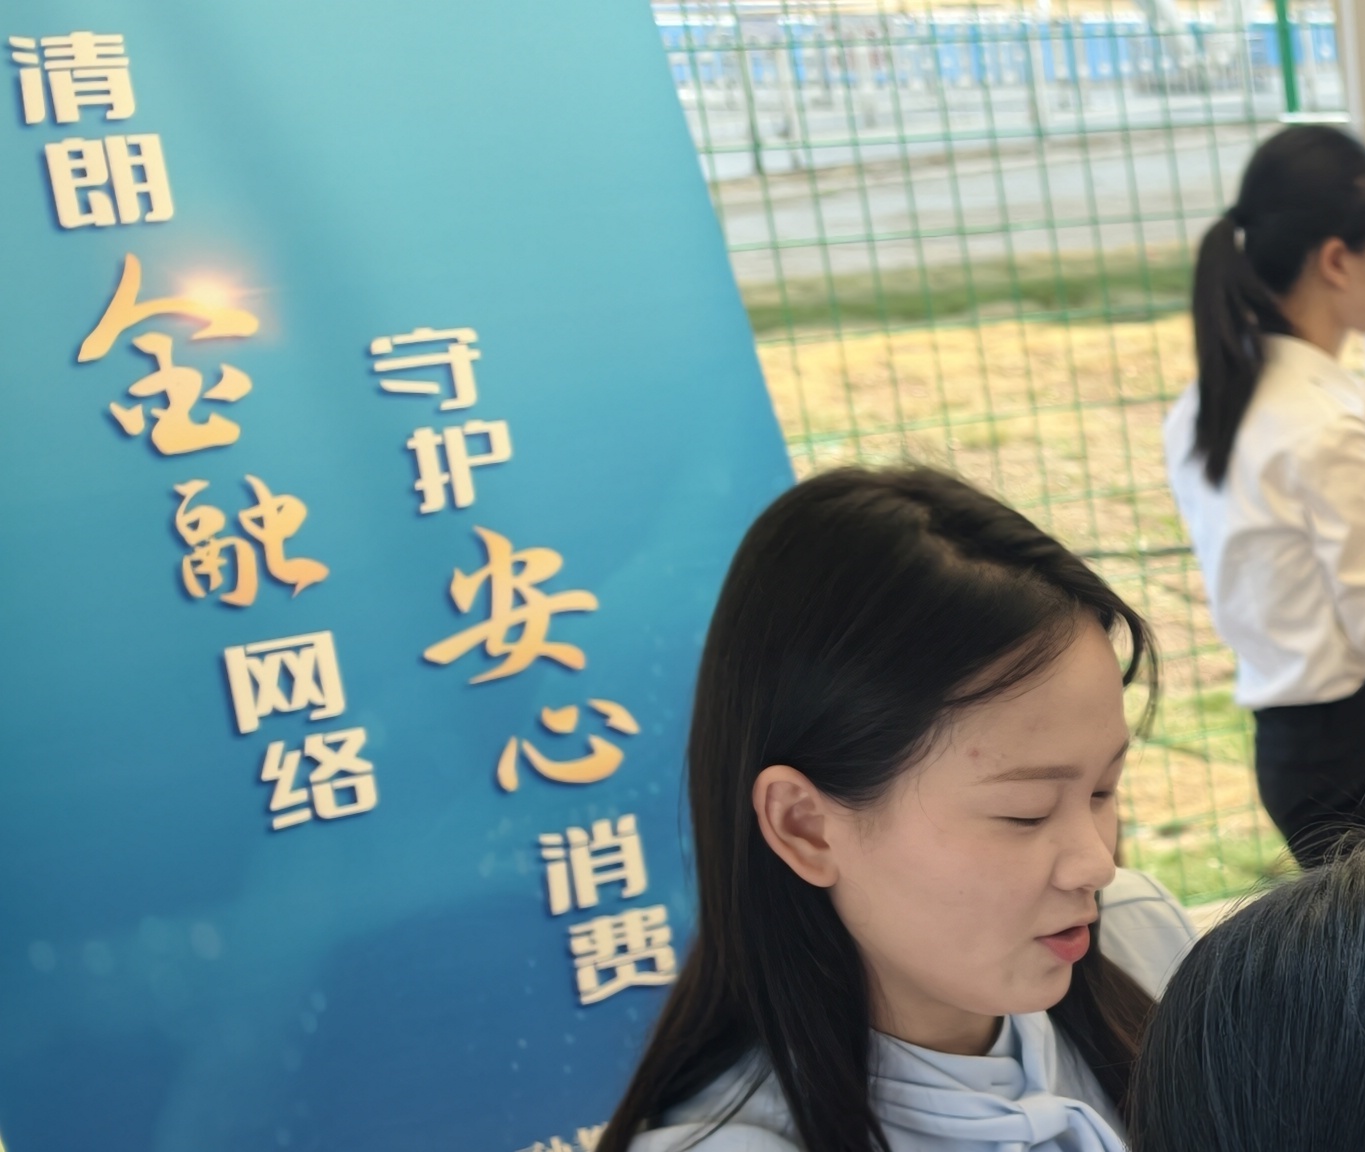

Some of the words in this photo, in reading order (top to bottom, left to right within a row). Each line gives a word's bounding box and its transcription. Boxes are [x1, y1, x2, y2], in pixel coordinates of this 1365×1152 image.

[8, 30, 379, 831] 清朗金融网络
[369, 326, 678, 1005] 守护安心消费
